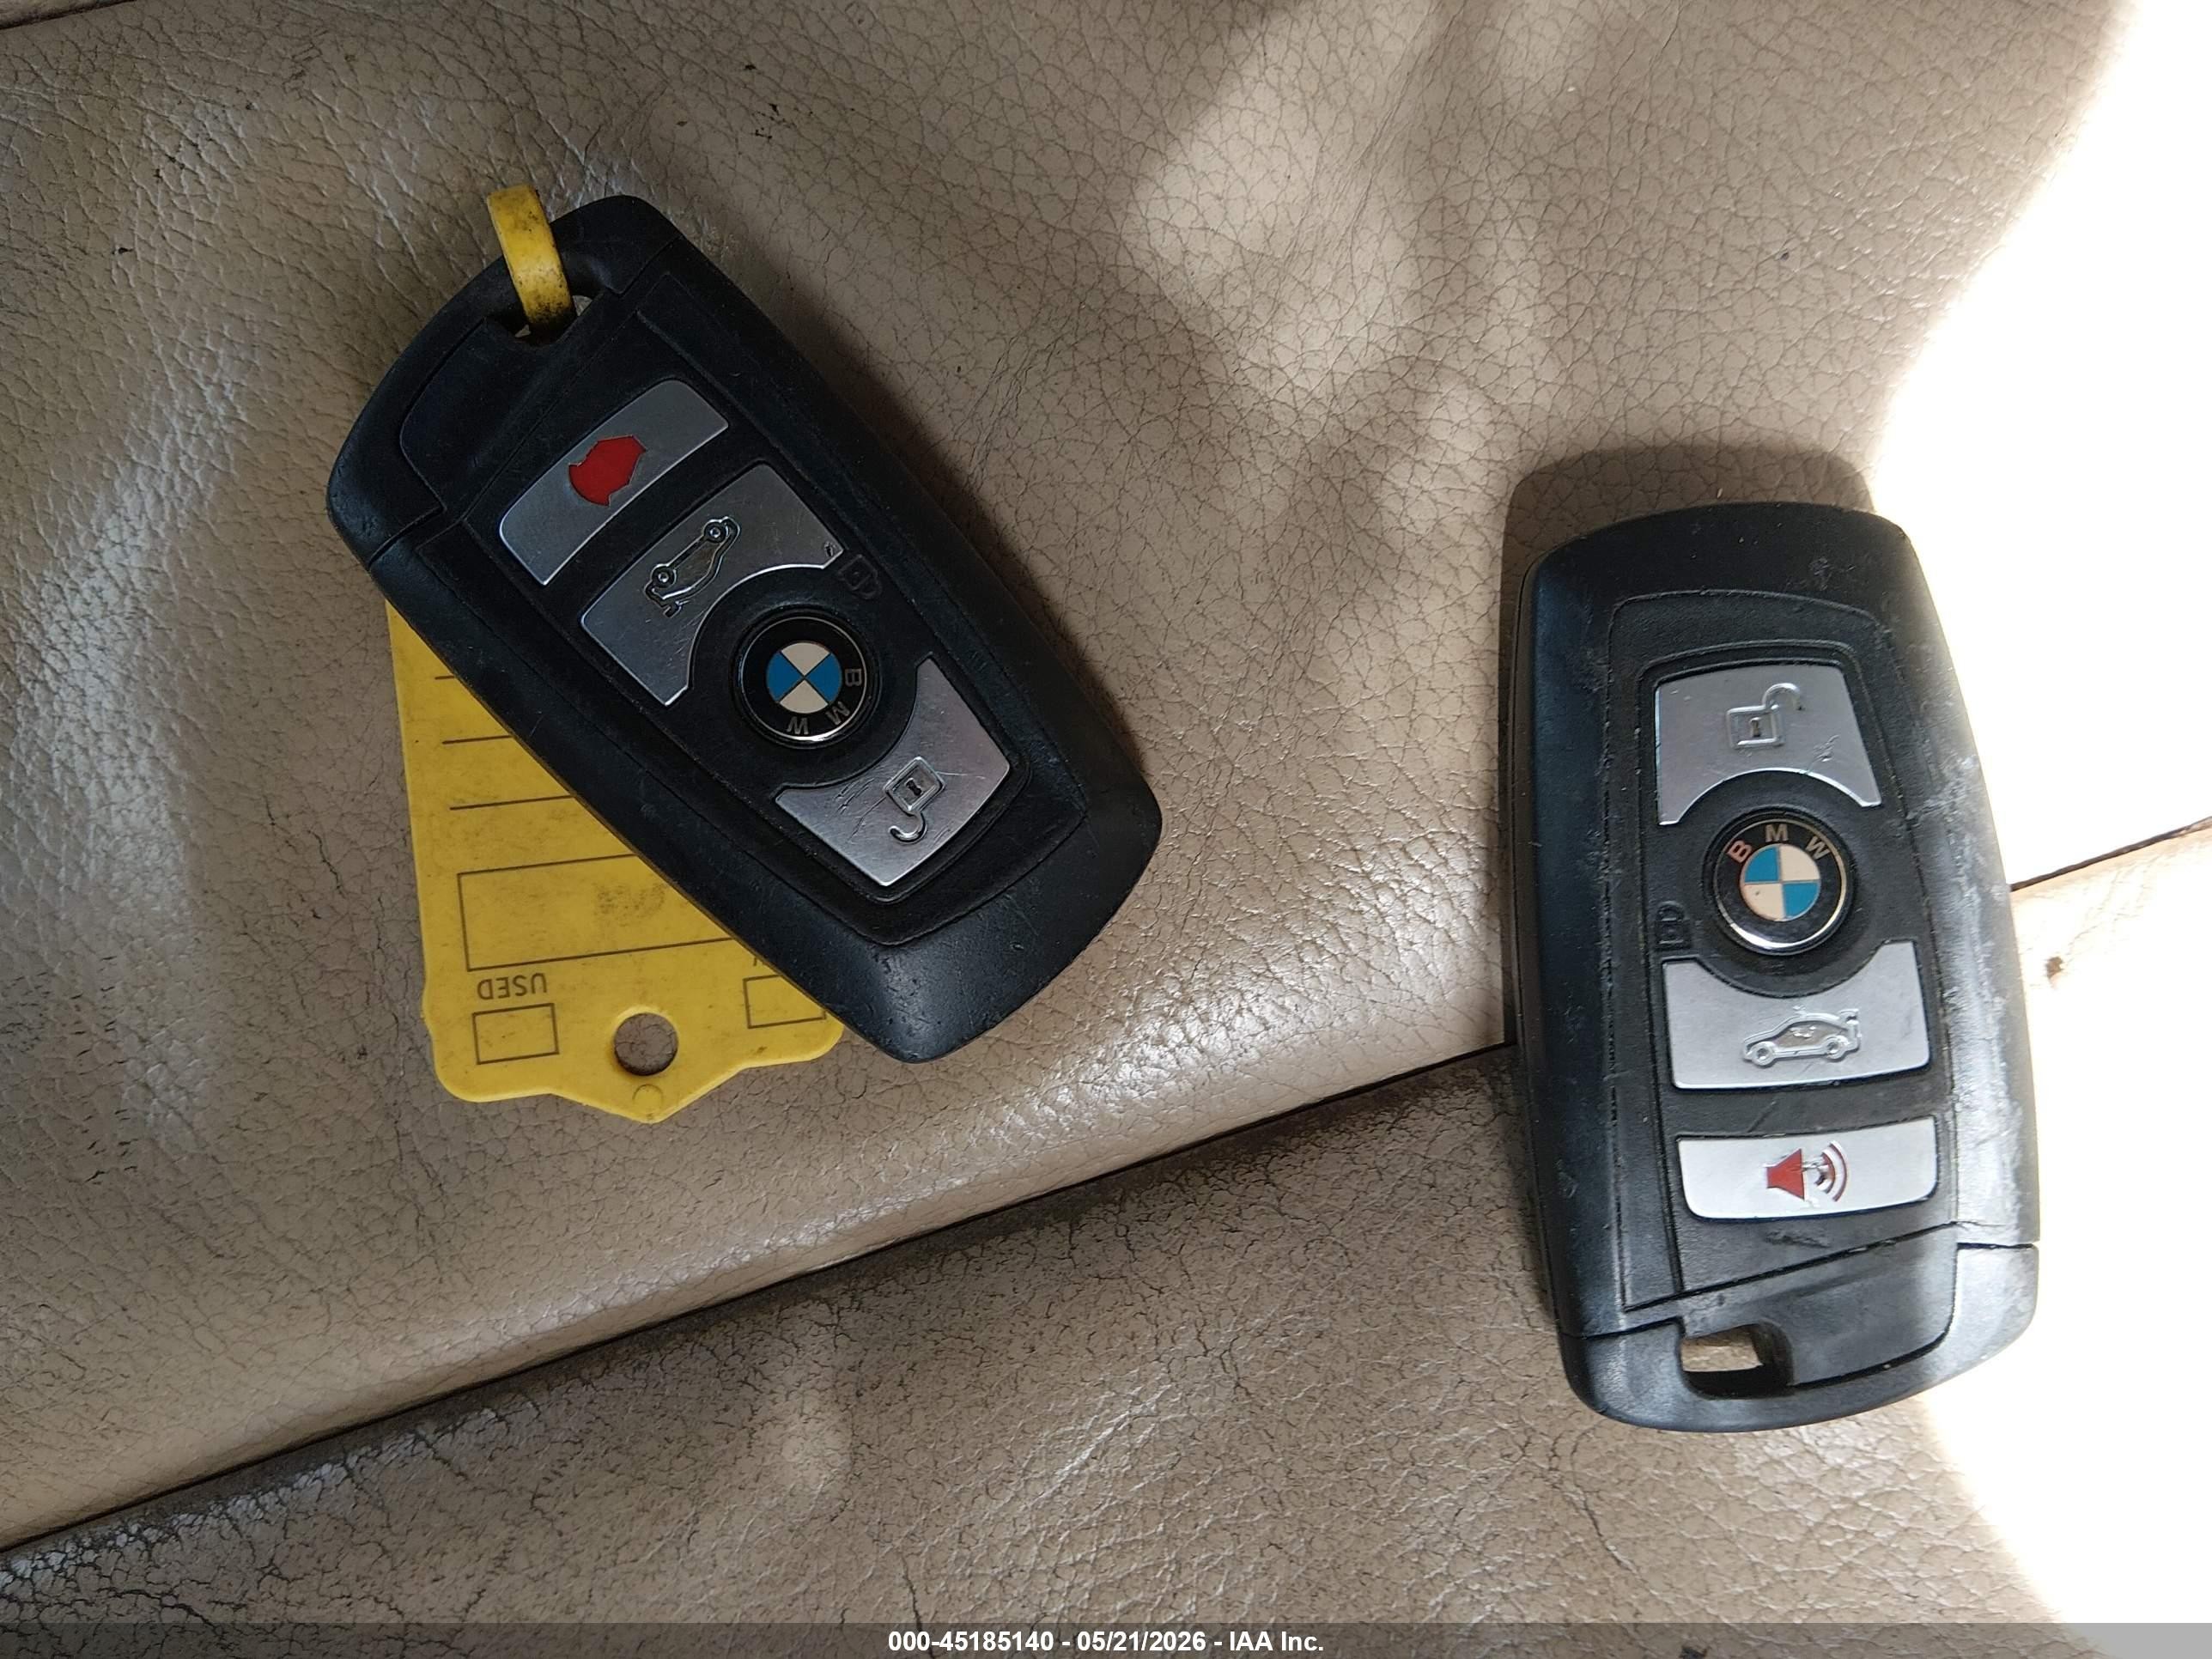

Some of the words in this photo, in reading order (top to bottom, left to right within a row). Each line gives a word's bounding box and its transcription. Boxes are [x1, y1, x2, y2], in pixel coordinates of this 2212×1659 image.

[787, 668, 862, 735] BMW
[1726, 823, 1831, 863] BMW
[477, 972, 548, 1000] USED
